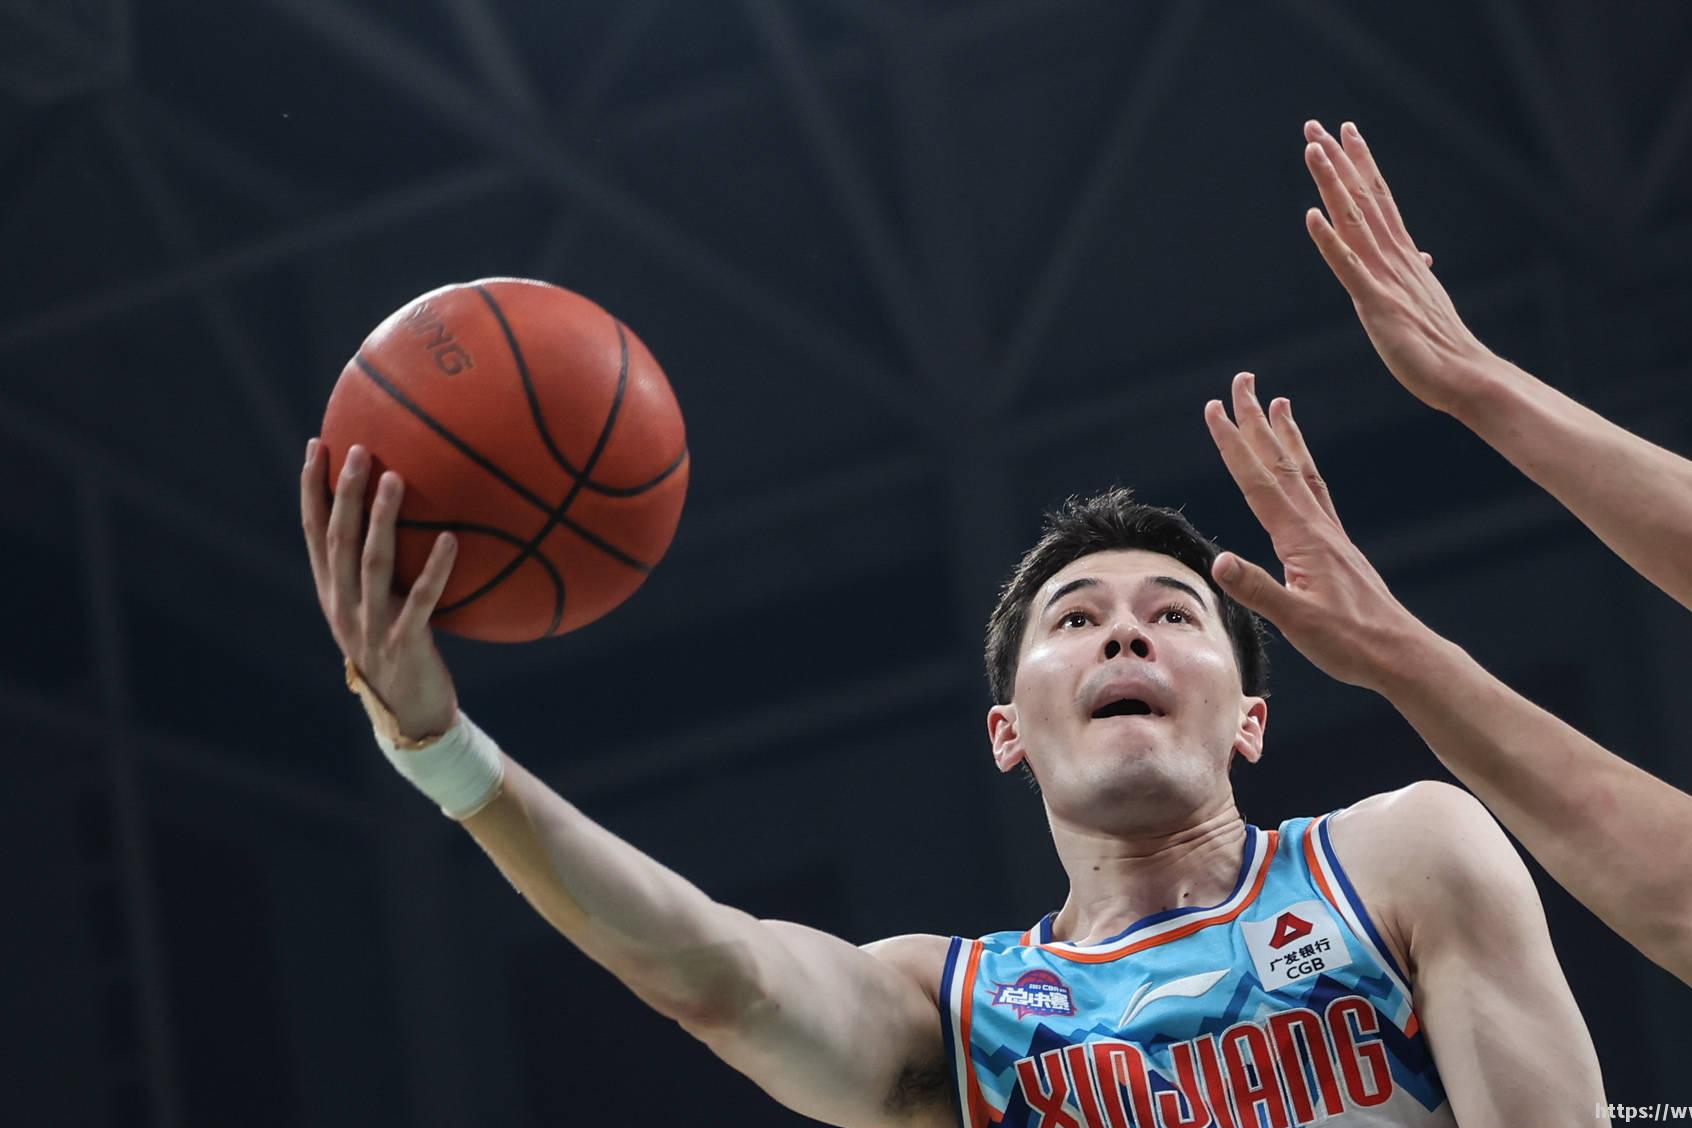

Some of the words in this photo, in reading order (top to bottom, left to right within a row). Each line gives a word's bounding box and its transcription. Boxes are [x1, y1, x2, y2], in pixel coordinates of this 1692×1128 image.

[1270, 938, 1331, 972] 广发银行
[1286, 957, 1325, 979] CGB
[999, 986, 1071, 1011] 总决赛
